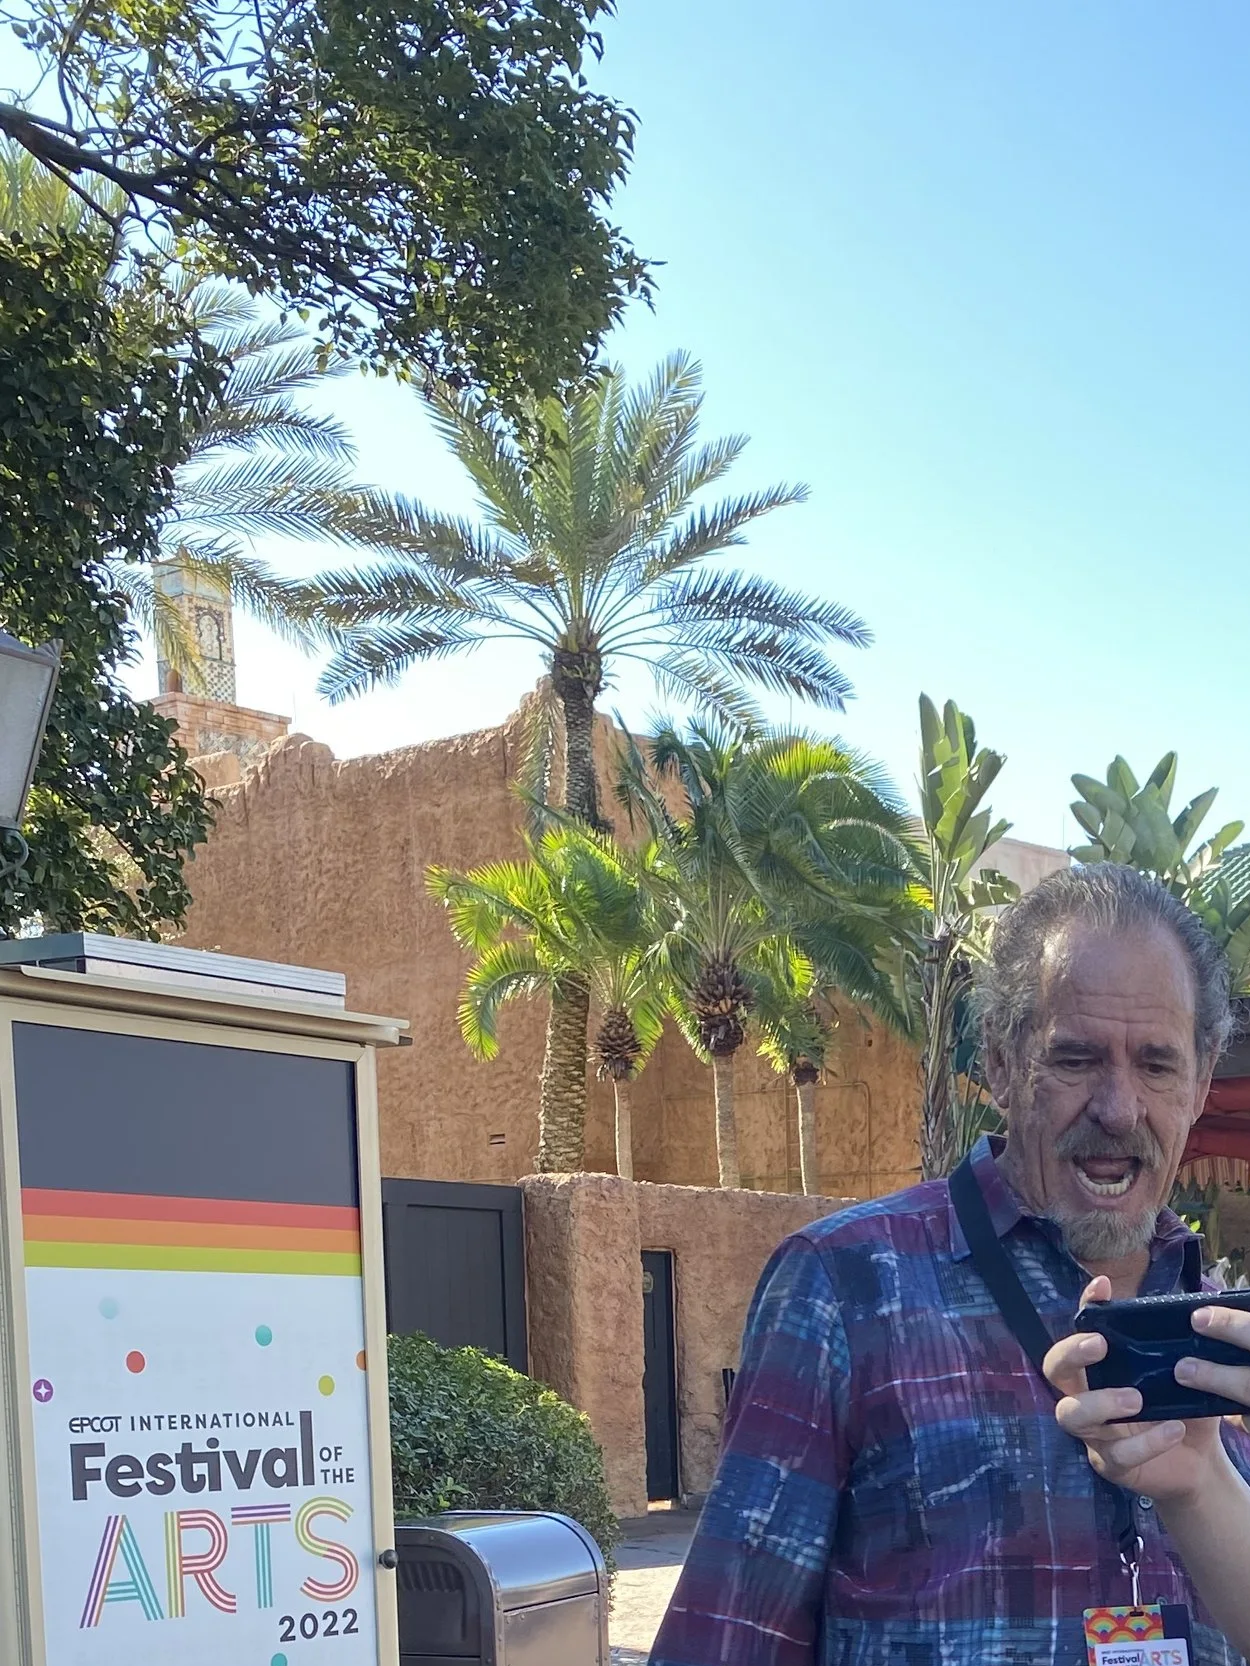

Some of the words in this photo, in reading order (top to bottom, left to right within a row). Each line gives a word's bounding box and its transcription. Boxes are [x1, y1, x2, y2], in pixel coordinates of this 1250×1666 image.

[68, 1416, 122, 1433] EPCOT
[130, 1411, 295, 1432] INTERNATIONAL
[69, 1410, 315, 1501] Festival
[318, 1446, 344, 1462] OF
[320, 1467, 356, 1484] THE
[79, 1496, 360, 1630] ARTS
[278, 1608, 359, 1643] 2022
[1102, 1653, 1140, 1666] Festival
[1140, 1649, 1183, 1666] ARTS
